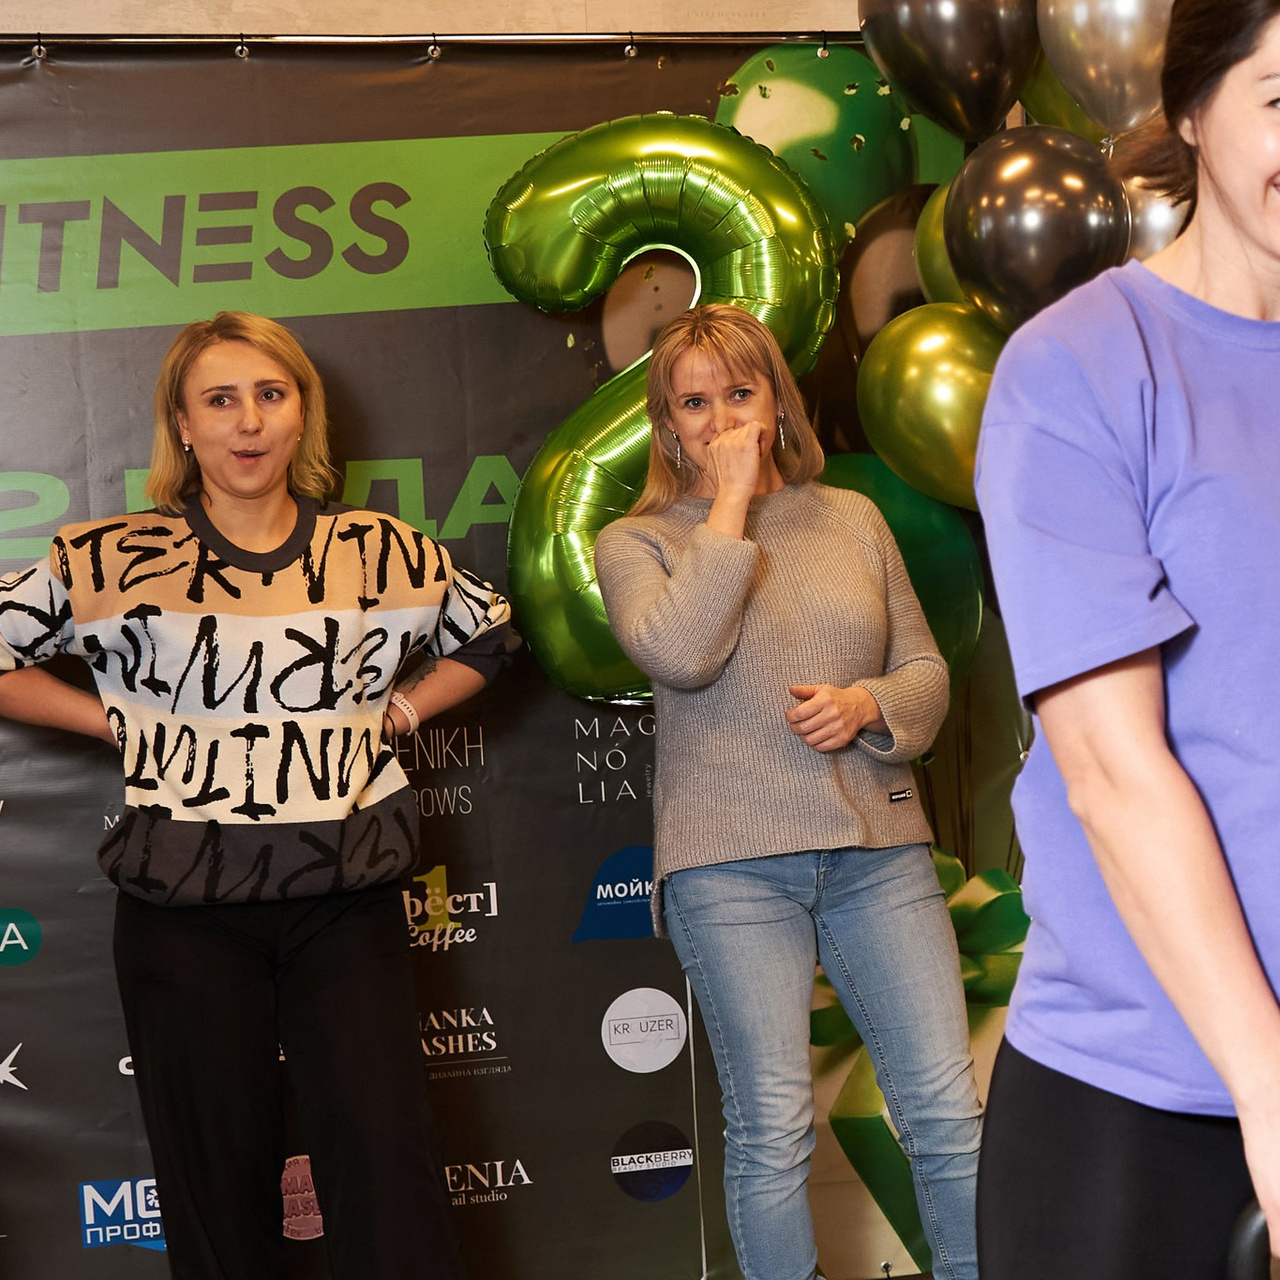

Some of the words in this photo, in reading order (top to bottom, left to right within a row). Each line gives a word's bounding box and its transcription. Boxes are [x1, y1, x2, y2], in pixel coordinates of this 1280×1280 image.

[0, 181, 411, 293] TNESS
[575, 714, 656, 739] MAG
[389, 726, 484, 772] ENIKH
[577, 742, 627, 773] NÓ
[578, 780, 637, 803] LIA
[419, 1007, 495, 1032] ANKA
[612, 1150, 693, 1167] BLACKBERRY
[470, 1190, 508, 1204] studio
